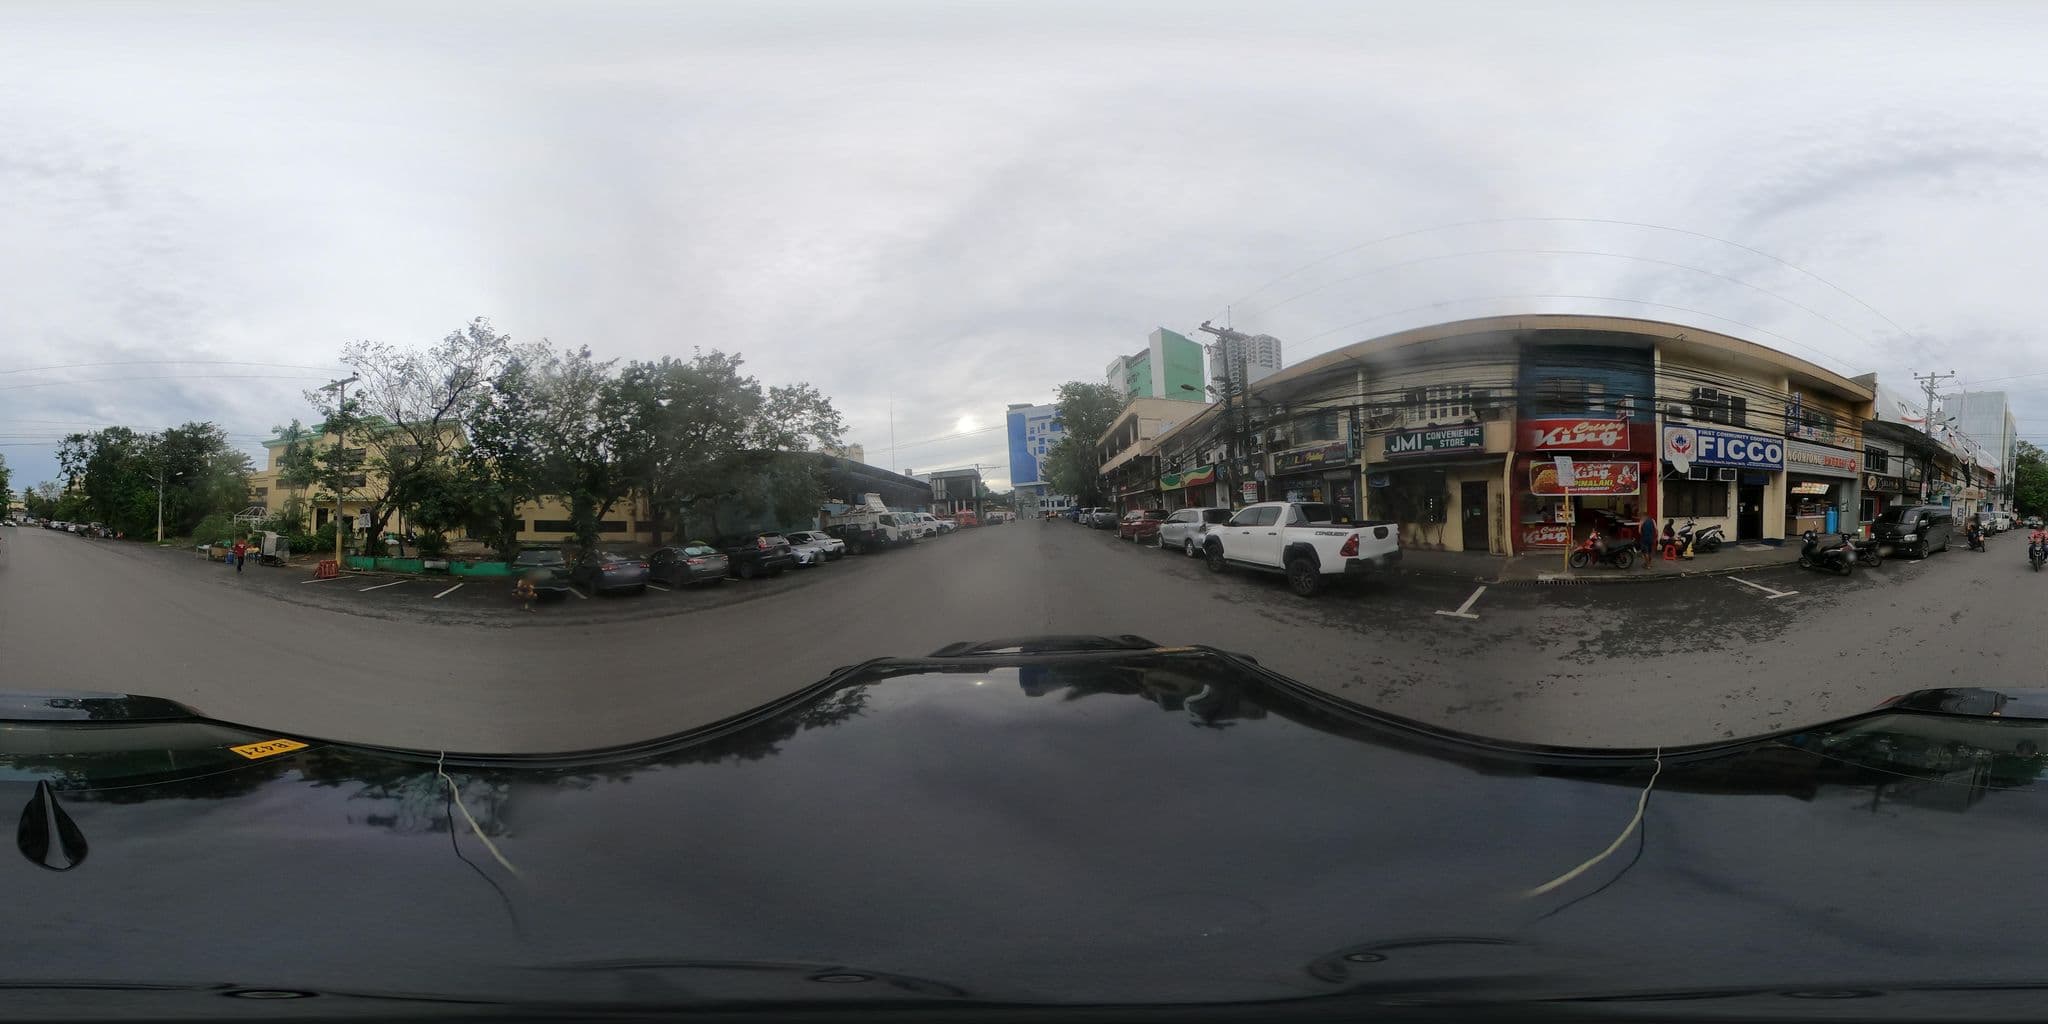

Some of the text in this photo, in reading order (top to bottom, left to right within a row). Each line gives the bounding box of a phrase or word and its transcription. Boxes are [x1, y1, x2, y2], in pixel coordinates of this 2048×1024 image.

[1426, 428, 1480, 440] CONVENIENCE
[1716, 431, 1749, 440] COMMUNITY
[1391, 433, 1422, 452] JMI
[1439, 438, 1465, 447] STORE
[1698, 436, 1782, 463] FICCO
